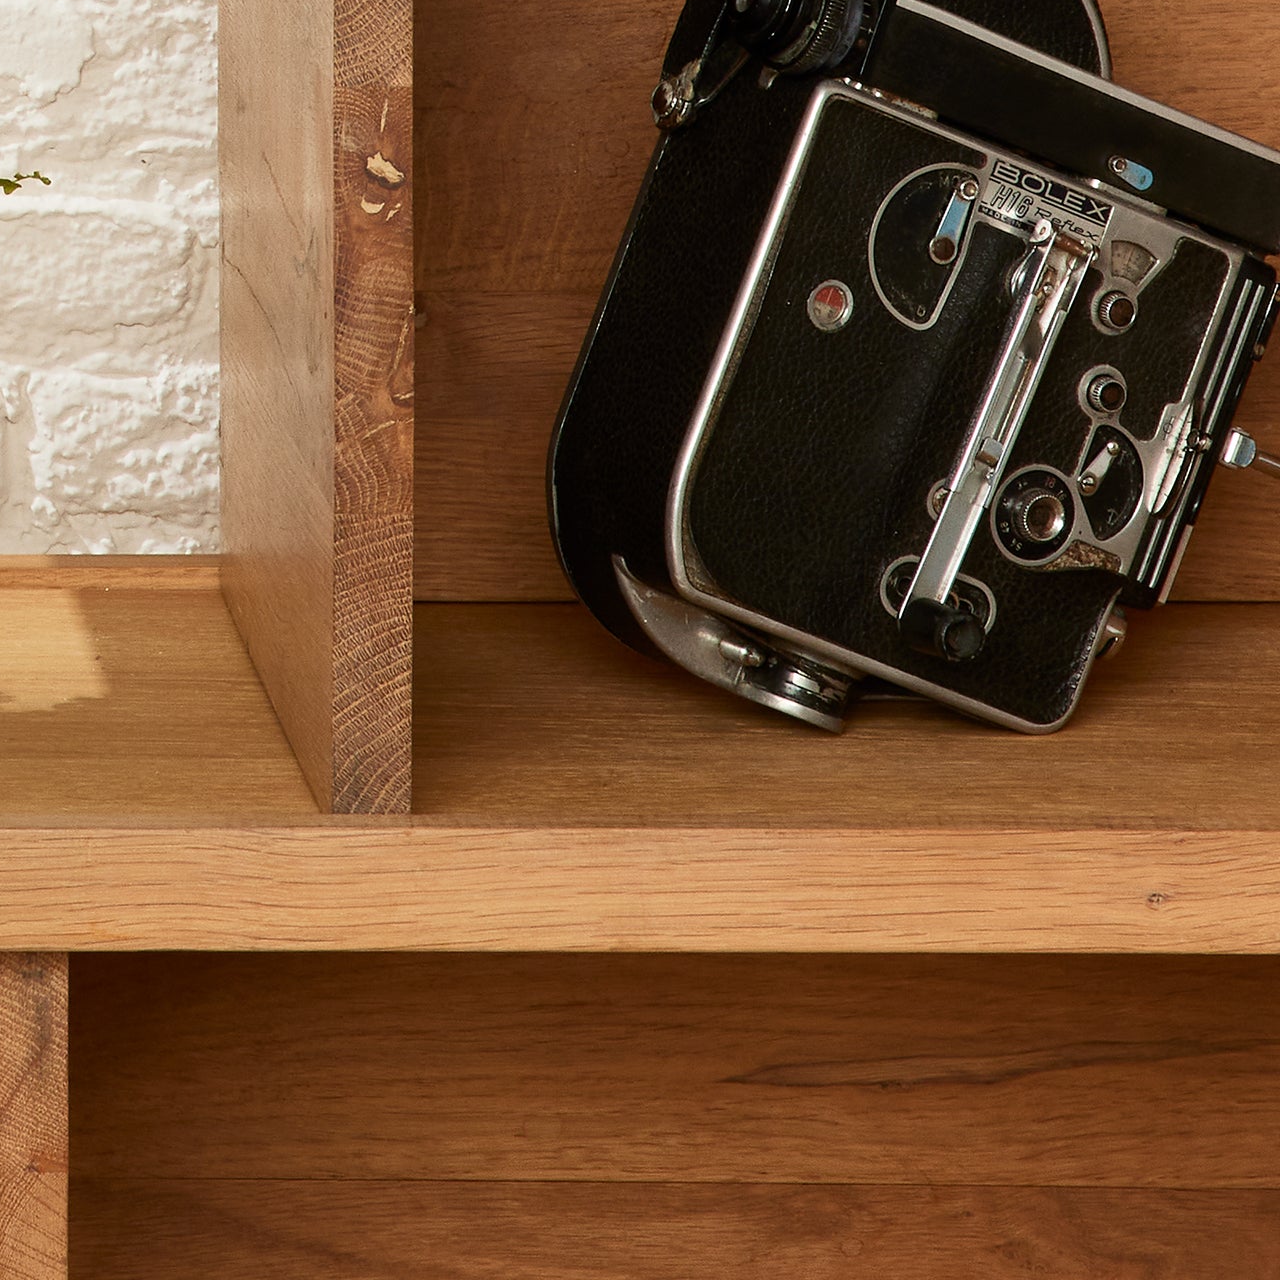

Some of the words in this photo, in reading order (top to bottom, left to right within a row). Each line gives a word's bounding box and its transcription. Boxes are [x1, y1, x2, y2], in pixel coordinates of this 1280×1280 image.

[990, 184, 1034, 218] H16
[1034, 206, 1100, 242] Reflex
[993, 161, 1108, 221] BOLEX
